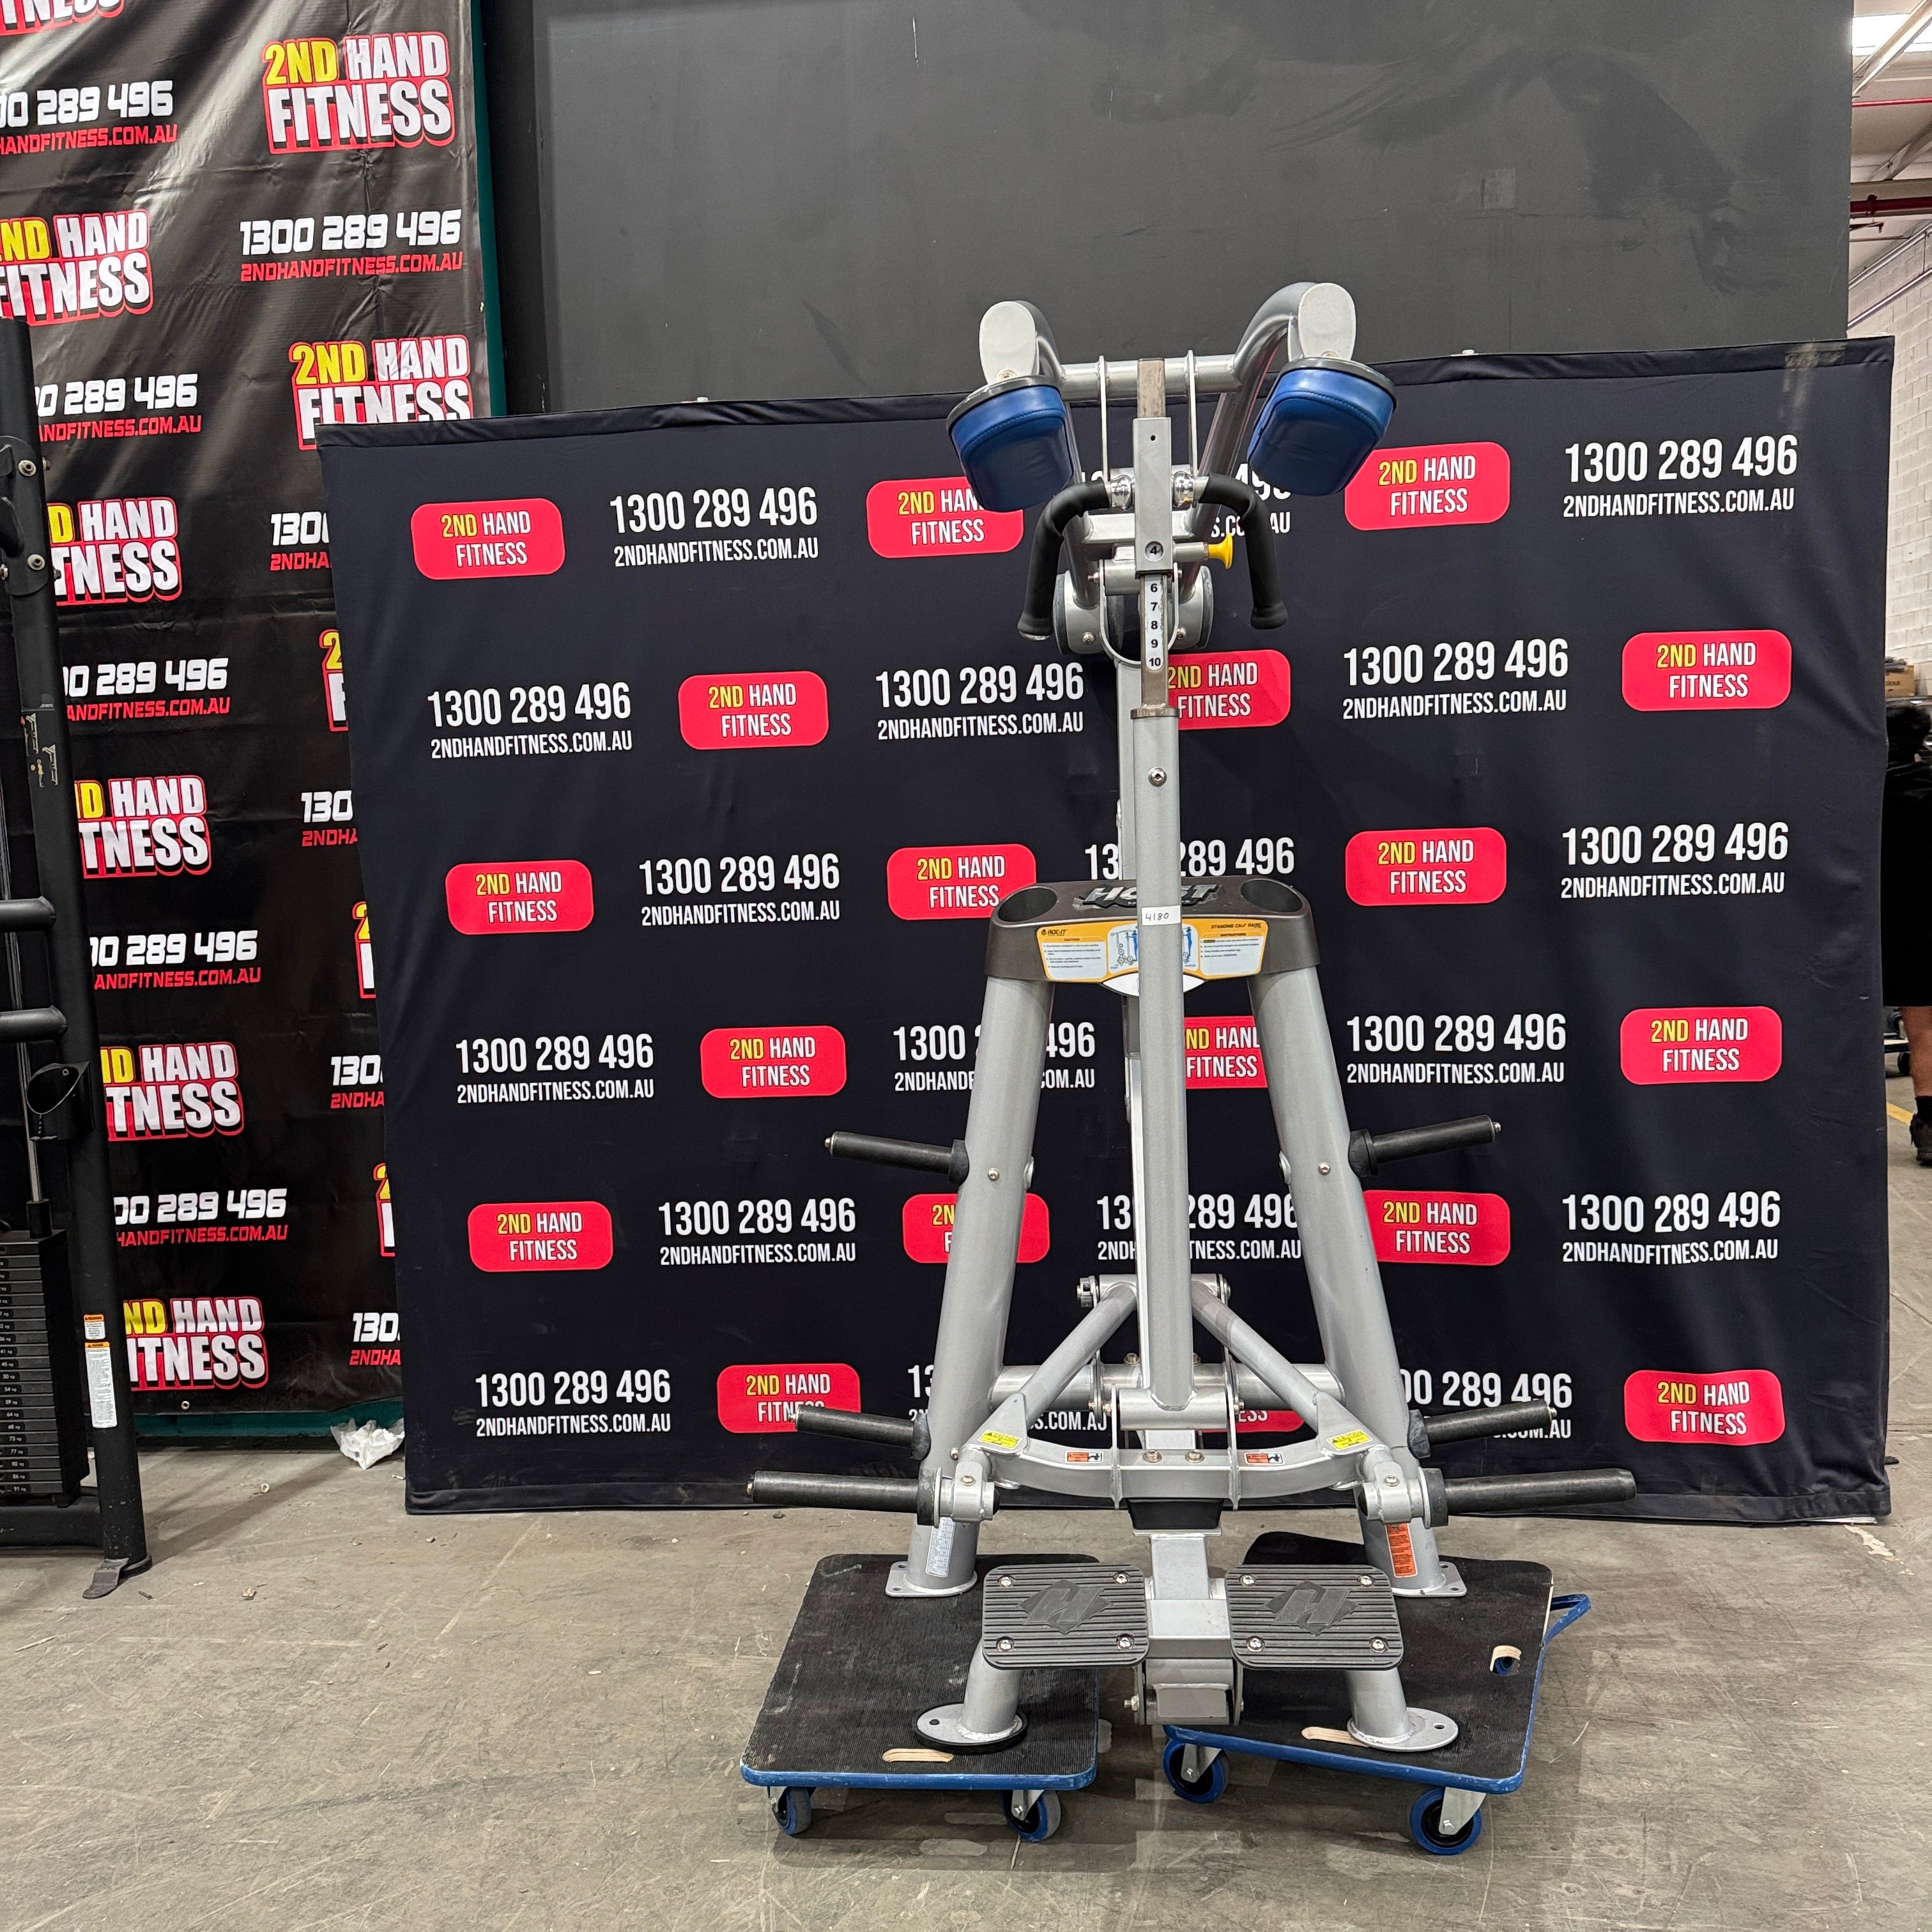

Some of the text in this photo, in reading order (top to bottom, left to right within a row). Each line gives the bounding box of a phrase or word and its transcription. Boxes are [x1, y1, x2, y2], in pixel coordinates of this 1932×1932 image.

[265, 34, 447, 84] 2ND HAND
[37, 87, 100, 125] 289
[107, 80, 172, 118] 496
[268, 79, 451, 142] FITNESS
[59, 211, 148, 256] HAND
[240, 209, 461, 255] 1300 289 496
[240, 251, 464, 282] 2NDHANDFITNESS.COM.AU
[293, 338, 468, 385] 2ND HAND
[64, 378, 125, 415] 289
[134, 374, 197, 409] 496
[1379, 456, 1475, 485] 2ND HAND
[1565, 434, 1797, 482] 1300 289 496
[610, 487, 817, 533] 1300 289 496
[898, 491, 934, 514] 2ND
[1391, 488, 1468, 516] FITNESS
[1563, 488, 1794, 517] 2NDHANDFITNESS.COM.AU
[80, 500, 175, 541] HAND
[441, 511, 530, 537] 2ND HAND
[912, 519, 984, 544] FITNESS
[456, 542, 527, 567] FITNESS
[614, 537, 818, 567] 2NDHANDFITNESS.COM.AU
[1150, 546, 1157, 555] 4
[1151, 583, 1158, 592] 6
[1151, 602, 1158, 611] 7
[1151, 621, 1158, 630] 8
[1151, 640, 1158, 648] 9
[1657, 643, 1756, 668] 2ND HAND
[1149, 658, 1161, 666] 10
[1344, 638, 1568, 686] 1300 289 496
[96, 662, 157, 695] 289
[165, 658, 228, 691] 496
[876, 663, 1083, 707] 1300 289 496
[1168, 663, 1257, 690] 2ND HAND
[1670, 674, 1748, 698] FITNESS
[427, 682, 631, 726] 1300 289 496
[709, 684, 796, 708] 2ND HAND
[1177, 693, 1250, 718] FITNESS
[1343, 689, 1566, 719] 2NDHANDFITNESS.COM.AU
[722, 713, 791, 737] FITNESS
[878, 712, 1083, 740] 2NDHANDFITNESS.COM.AU
[431, 730, 632, 758] 2NDHANDFITNESS.COM.AU
[111, 778, 204, 816] HAND
[79, 816, 208, 868] TNESS
[1379, 840, 1473, 864] 2ND HAND
[1563, 822, 1788, 864] 1300 289 496
[917, 856, 1004, 880] 2ND HAND
[1236, 838, 1294, 875] 496
[476, 871, 561, 895] 2ND HAND
[640, 854, 839, 894] 1300 289 496
[1391, 870, 1466, 893] FITNESS
[1561, 872, 1784, 898] 2NDHANDFITNESS.COM.AU
[930, 885, 999, 908] FITNESS
[489, 900, 556, 923] FITNESS
[641, 900, 839, 926] 2NDHANDFITNESS.COM.AU
[1146, 912, 1169, 921] 4180
[126, 933, 186, 965] 289
[194, 930, 257, 962] 496
[894, 1025, 965, 1061] 1300
[1186, 1028, 1209, 1049] ND
[1347, 1014, 1565, 1052] 1300 289 496
[1652, 1018, 1747, 1042] 2ND HAND
[456, 1034, 653, 1073] 1300 289 496
[730, 1037, 815, 1059] 2ND HAND
[1664, 1048, 1739, 1071] FITNESS
[142, 1045, 235, 1082] HAND
[742, 1065, 809, 1087] FITNESS
[1186, 1056, 1257, 1078] FITNESS
[1347, 1062, 1563, 1084] 2NDHANDFITNESS.COM.AU
[457, 1079, 654, 1103] 2NDHANDFITNESS.COM.AU
[105, 1081, 240, 1131] TNESS
[157, 1188, 287, 1222] 289 496
[659, 1198, 855, 1235] 1300 289 496
[1244, 1193, 1298, 1228] 496
[1384, 1202, 1476, 1225] 2ND HAND
[1563, 1191, 1780, 1232] 1300 289 496
[498, 1213, 581, 1234] 2ND HAND
[510, 1239, 577, 1261] FITNESS
[661, 1243, 855, 1265] 2NDHANDFITNESS.COM.AU
[1397, 1230, 1469, 1254] FITNESS
[1563, 1239, 1777, 1264] 2NDHANDFITNESS.COM.AU
[172, 1300, 261, 1333] HAND
[353, 1313, 399, 1342] 130
[475, 1369, 670, 1407] 1300 289 496
[746, 1374, 830, 1395] 2ND HAND
[1442, 1370, 1572, 1408] 289 496
[1658, 1381, 1749, 1406] 2ND HAND
[477, 1413, 670, 1436] 2NDHANDFITNESS.COM.AU
[1671, 1411, 1746, 1434] FITNESS
